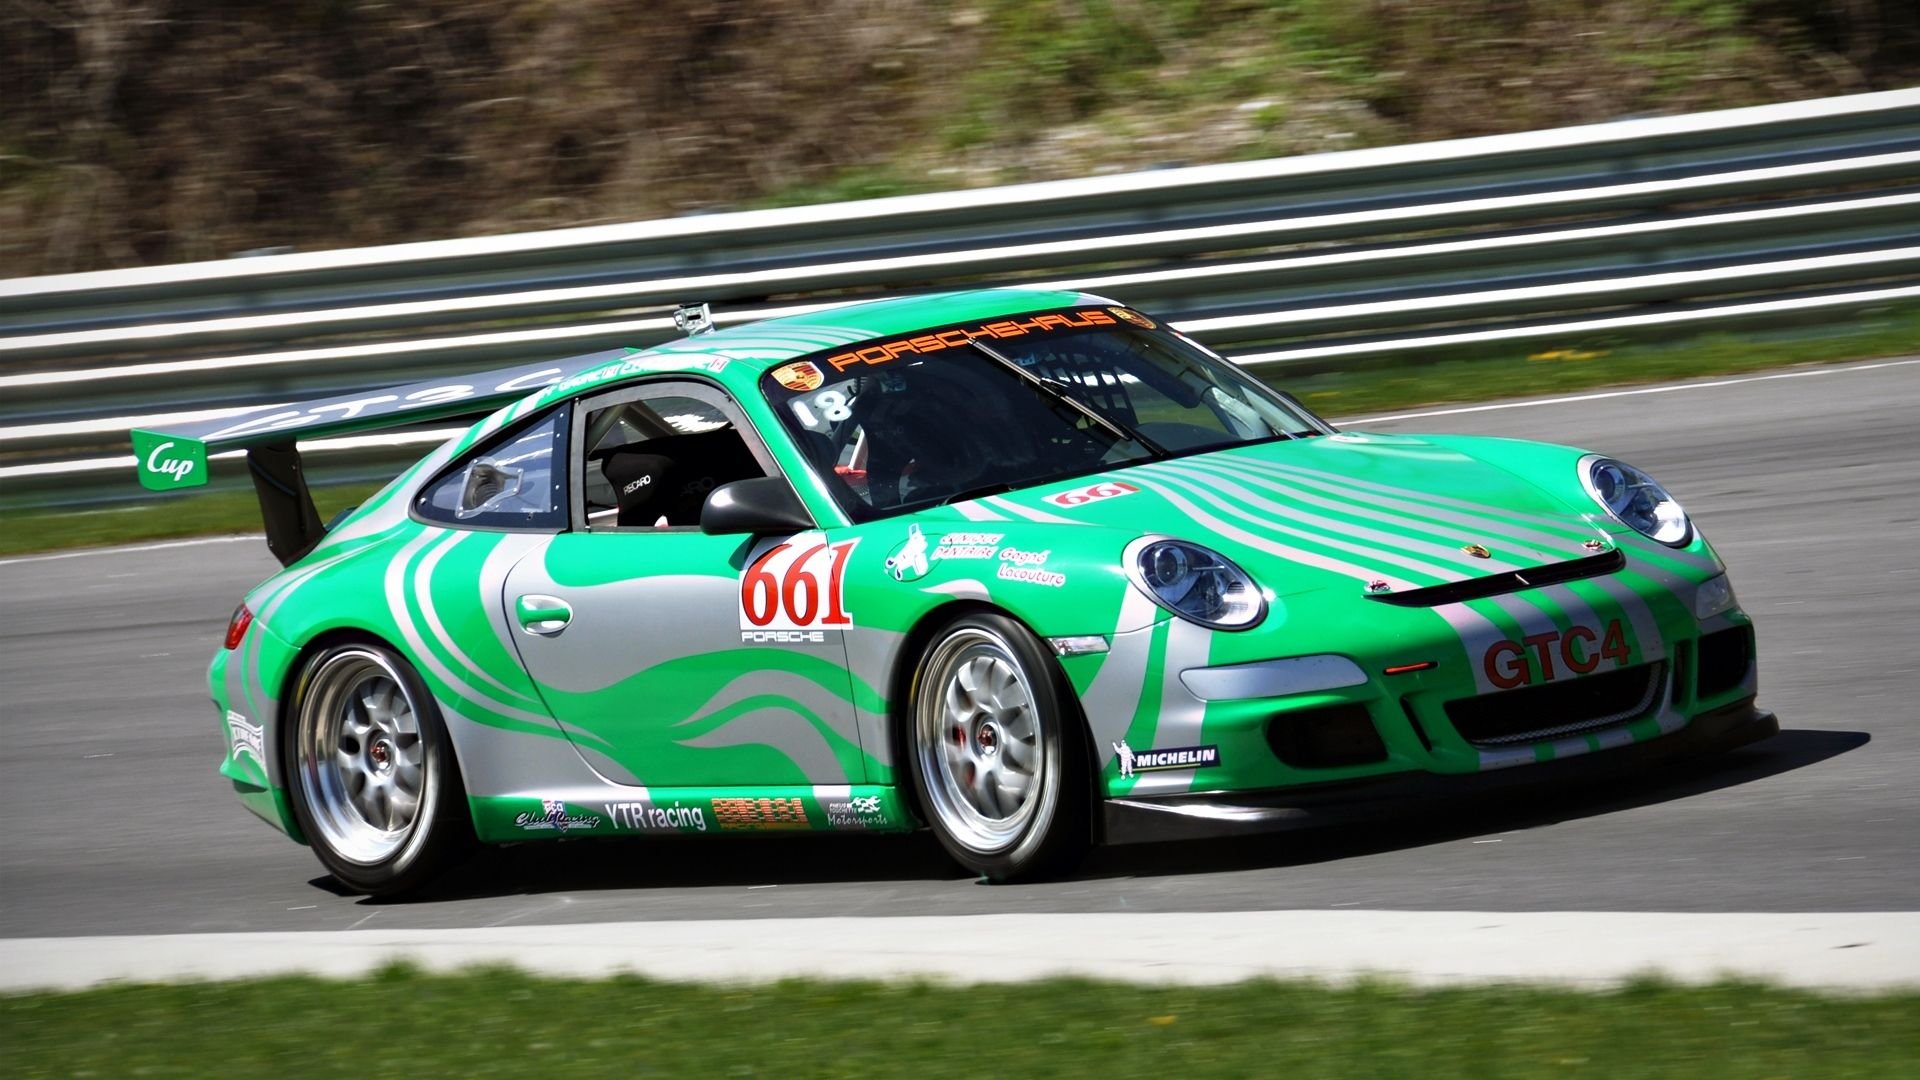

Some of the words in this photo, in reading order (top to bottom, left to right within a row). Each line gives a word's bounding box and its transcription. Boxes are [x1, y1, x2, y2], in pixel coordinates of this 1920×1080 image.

[827, 311, 1117, 372] PORSCHEHAUS
[793, 390, 852, 427] 18
[147, 441, 194, 481] Cup
[623, 474, 651, 496] RECARO
[1055, 482, 1140, 505] 661
[742, 543, 854, 626] 661
[998, 564, 1065, 586] Lacouture
[741, 631, 824, 642] PORSCHE
[1483, 618, 1631, 690] GTC4
[1136, 748, 1215, 767] MICHELIN
[604, 802, 647, 829] YTR
[647, 800, 706, 831] racing
[827, 812, 889, 828] Motorsports
